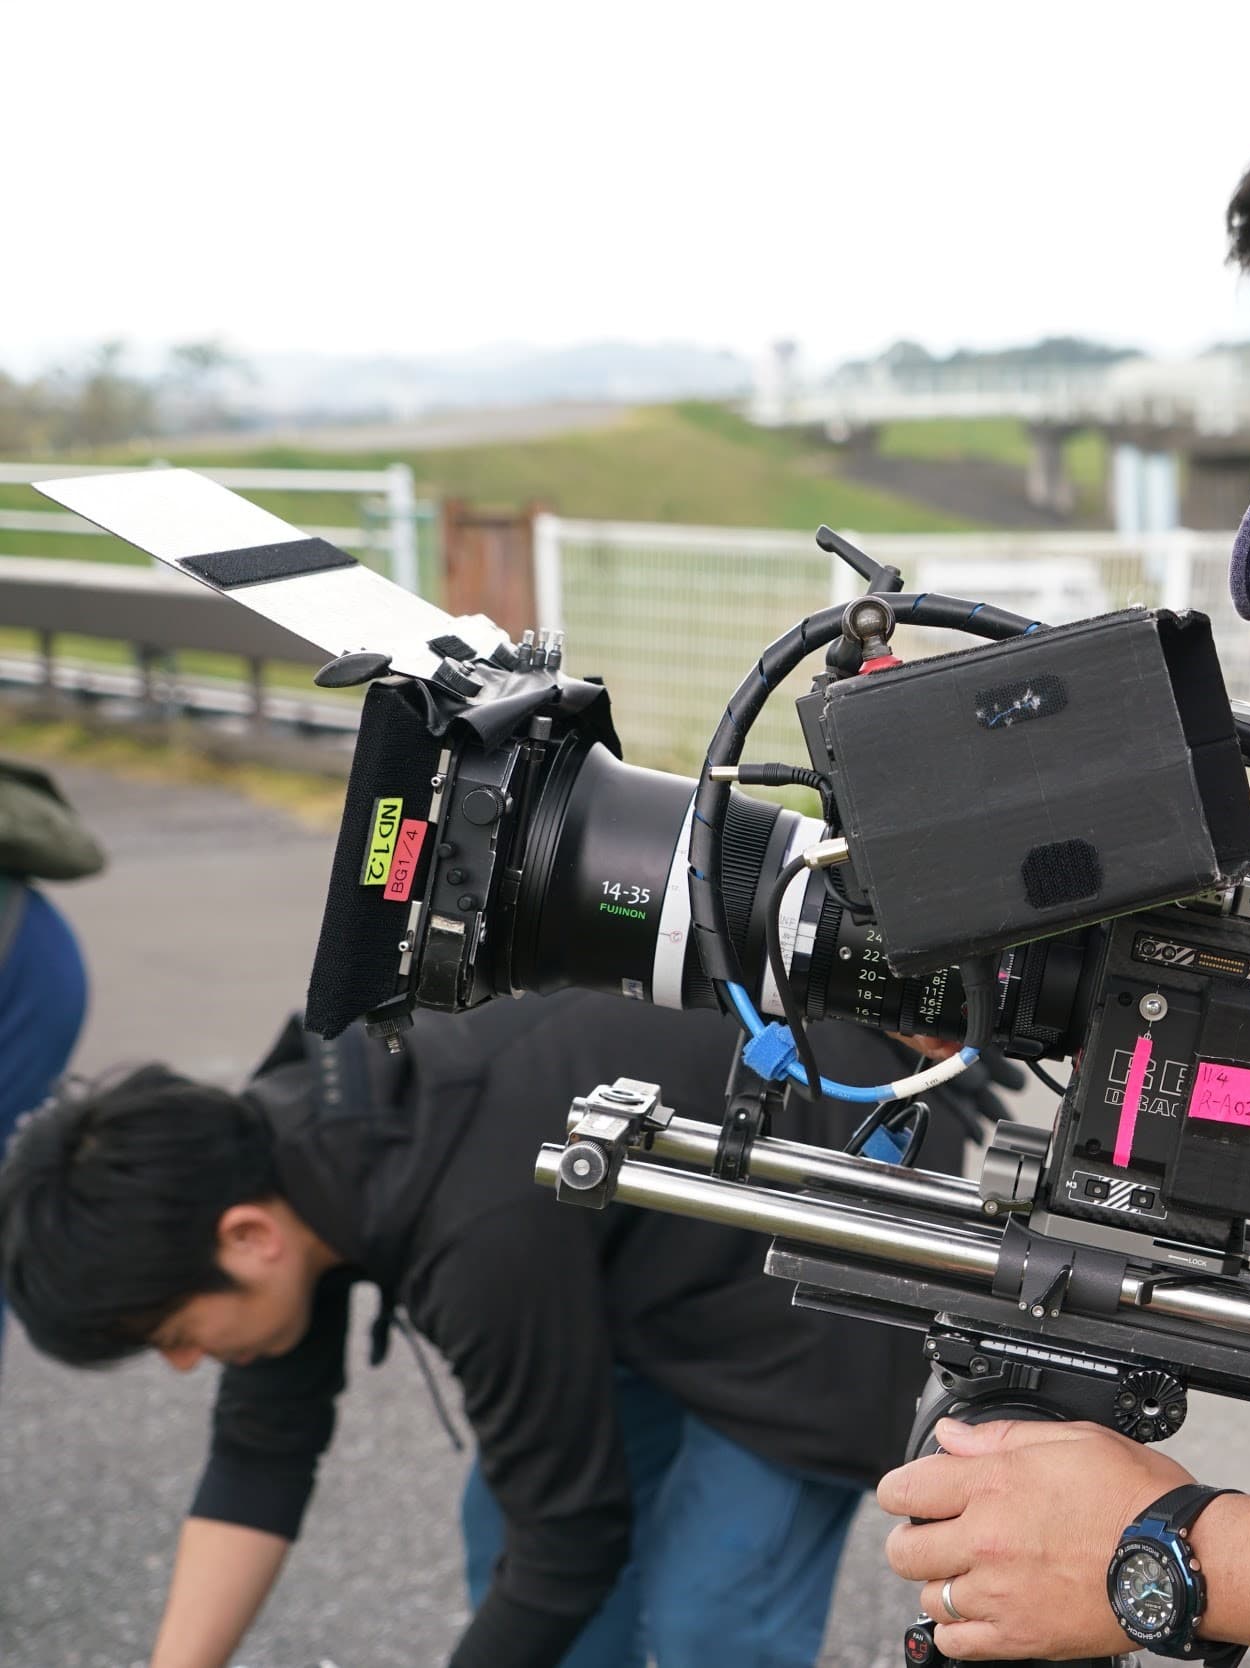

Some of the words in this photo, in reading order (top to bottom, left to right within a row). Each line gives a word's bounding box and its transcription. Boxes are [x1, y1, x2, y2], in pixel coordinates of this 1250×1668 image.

[391, 829, 418, 894] BG1/4
[602, 880, 651, 905] 14-35
[599, 902, 647, 920] FUJINON
[862, 949, 880, 962] 22
[859, 969, 877, 982] 20
[932, 976, 941, 985] 8
[857, 989, 872, 1000] 18
[925, 986, 937, 996] 11
[922, 997, 936, 1006] 16
[855, 1007, 870, 1016] 16
[920, 1006, 935, 1015] 22
[1108, 1049, 1189, 1097] RE
[1187, 1257, 1208, 1268] LOCK
[1126, 1624, 1162, 1640] G-SHOCK
